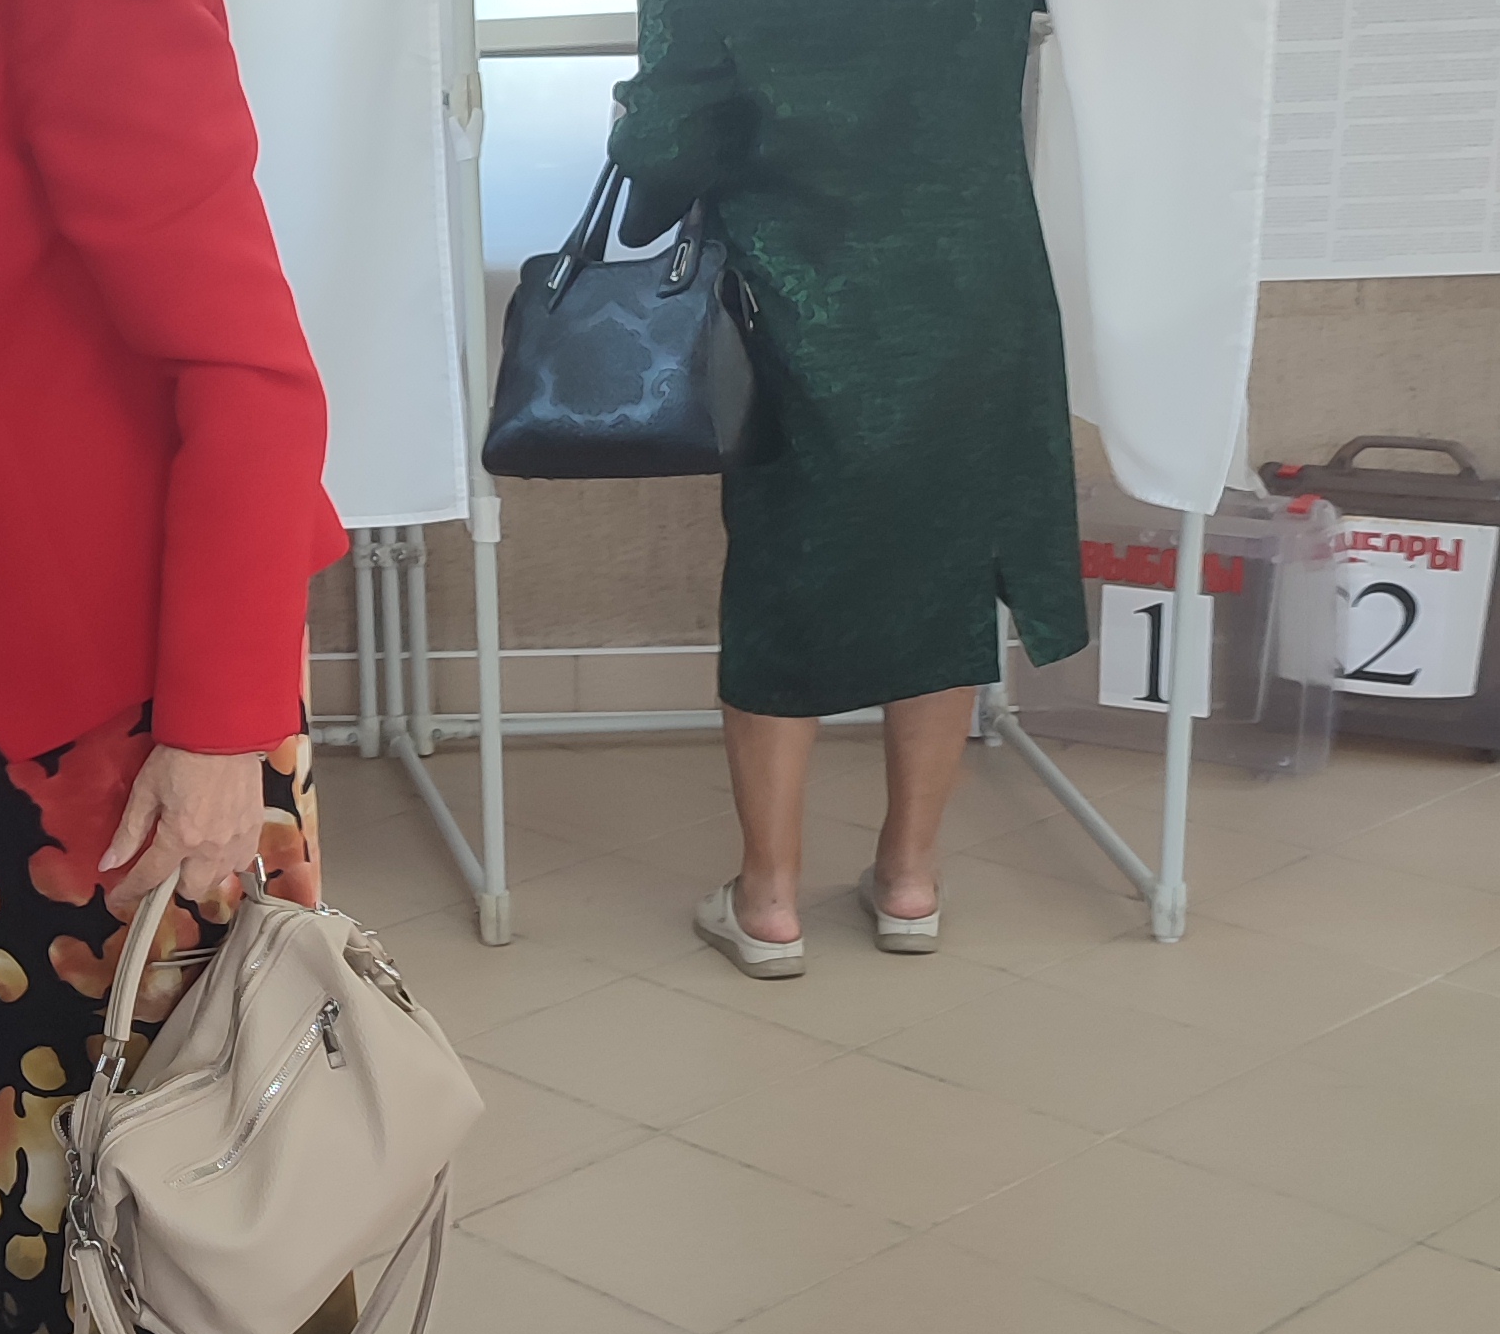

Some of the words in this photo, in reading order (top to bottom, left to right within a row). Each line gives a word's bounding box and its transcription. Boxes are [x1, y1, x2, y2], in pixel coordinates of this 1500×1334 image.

[1081, 540, 1244, 594] ВЫБОЫ
[1312, 529, 1463, 571] ЫБОРЫ
[1132, 602, 1169, 704] 1
[1343, 581, 1423, 686] 2
